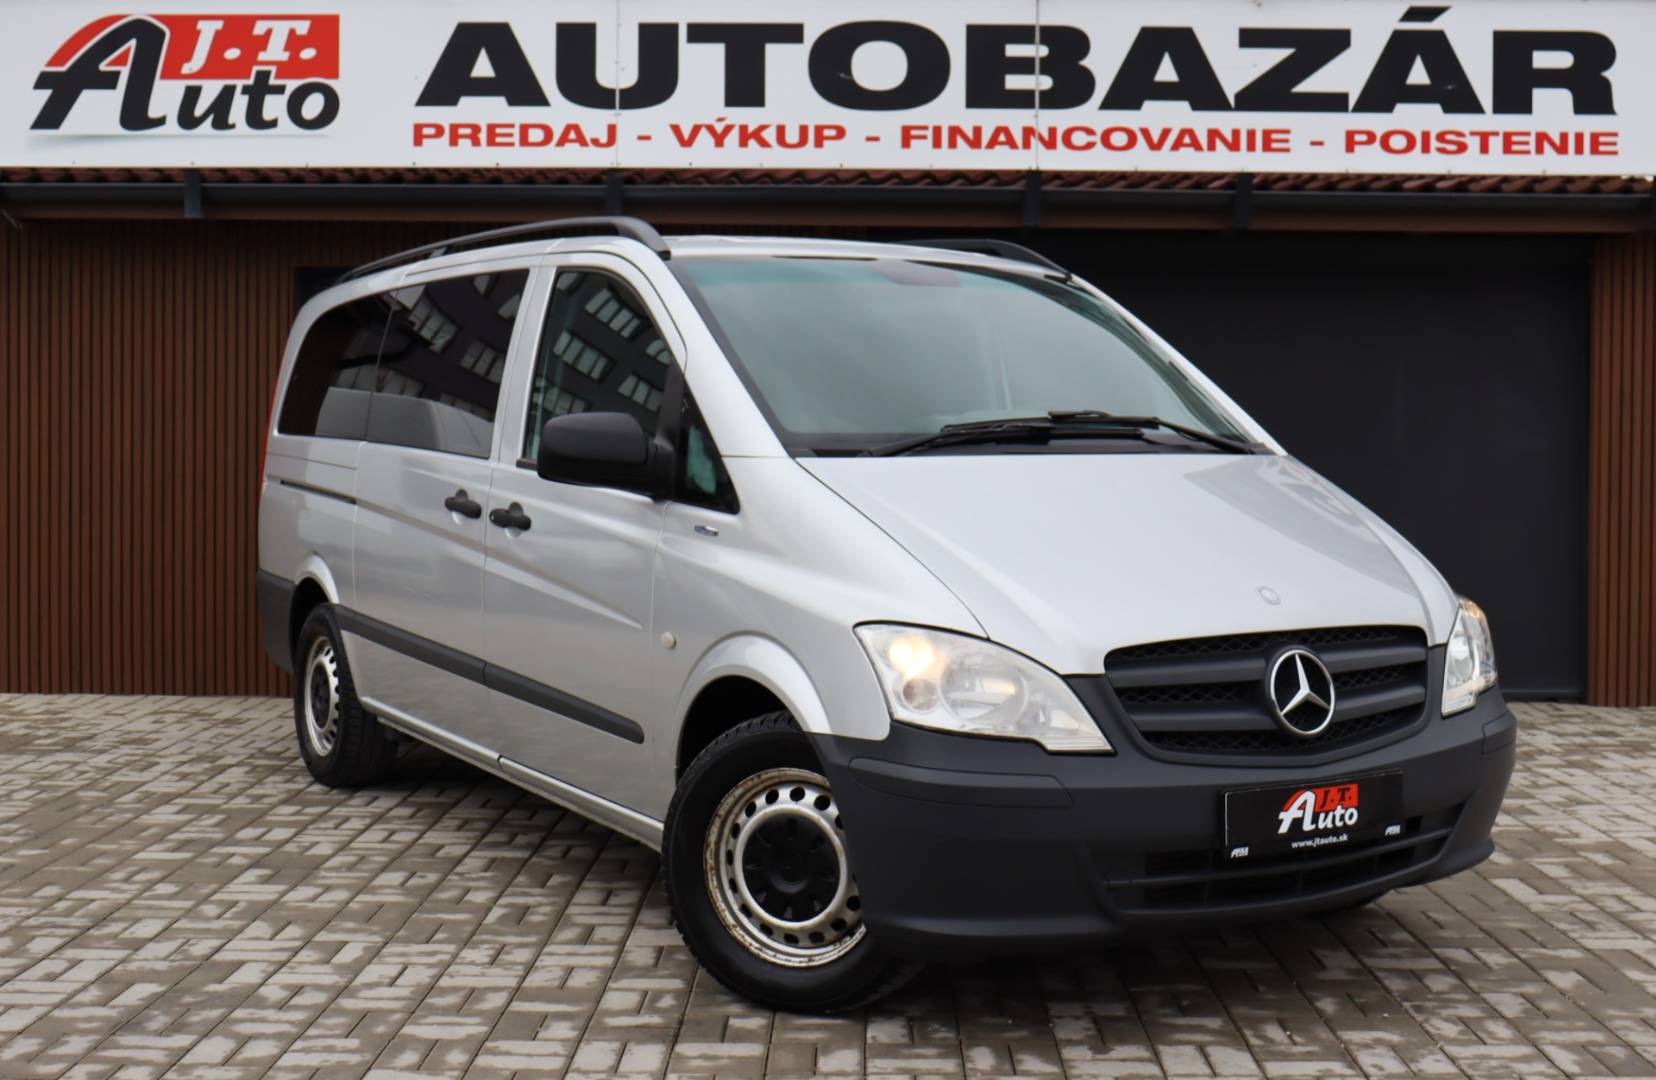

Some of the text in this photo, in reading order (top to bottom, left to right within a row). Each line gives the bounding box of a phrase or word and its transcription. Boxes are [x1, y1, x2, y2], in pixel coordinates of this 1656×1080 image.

[181, 19, 317, 75] J.T.
[415, 6, 1617, 115] AUTOBAZÁR
[30, 18, 340, 131] Auto
[413, 123, 617, 148] PREDAJ
[670, 117, 847, 148] VÝKUP
[900, 125, 1290, 153] FINANCOVANIE
[1345, 129, 1619, 155] POISTENIE
[1277, 790, 1359, 834] Auto
[1291, 832, 1349, 848] www.jtauto.sk
